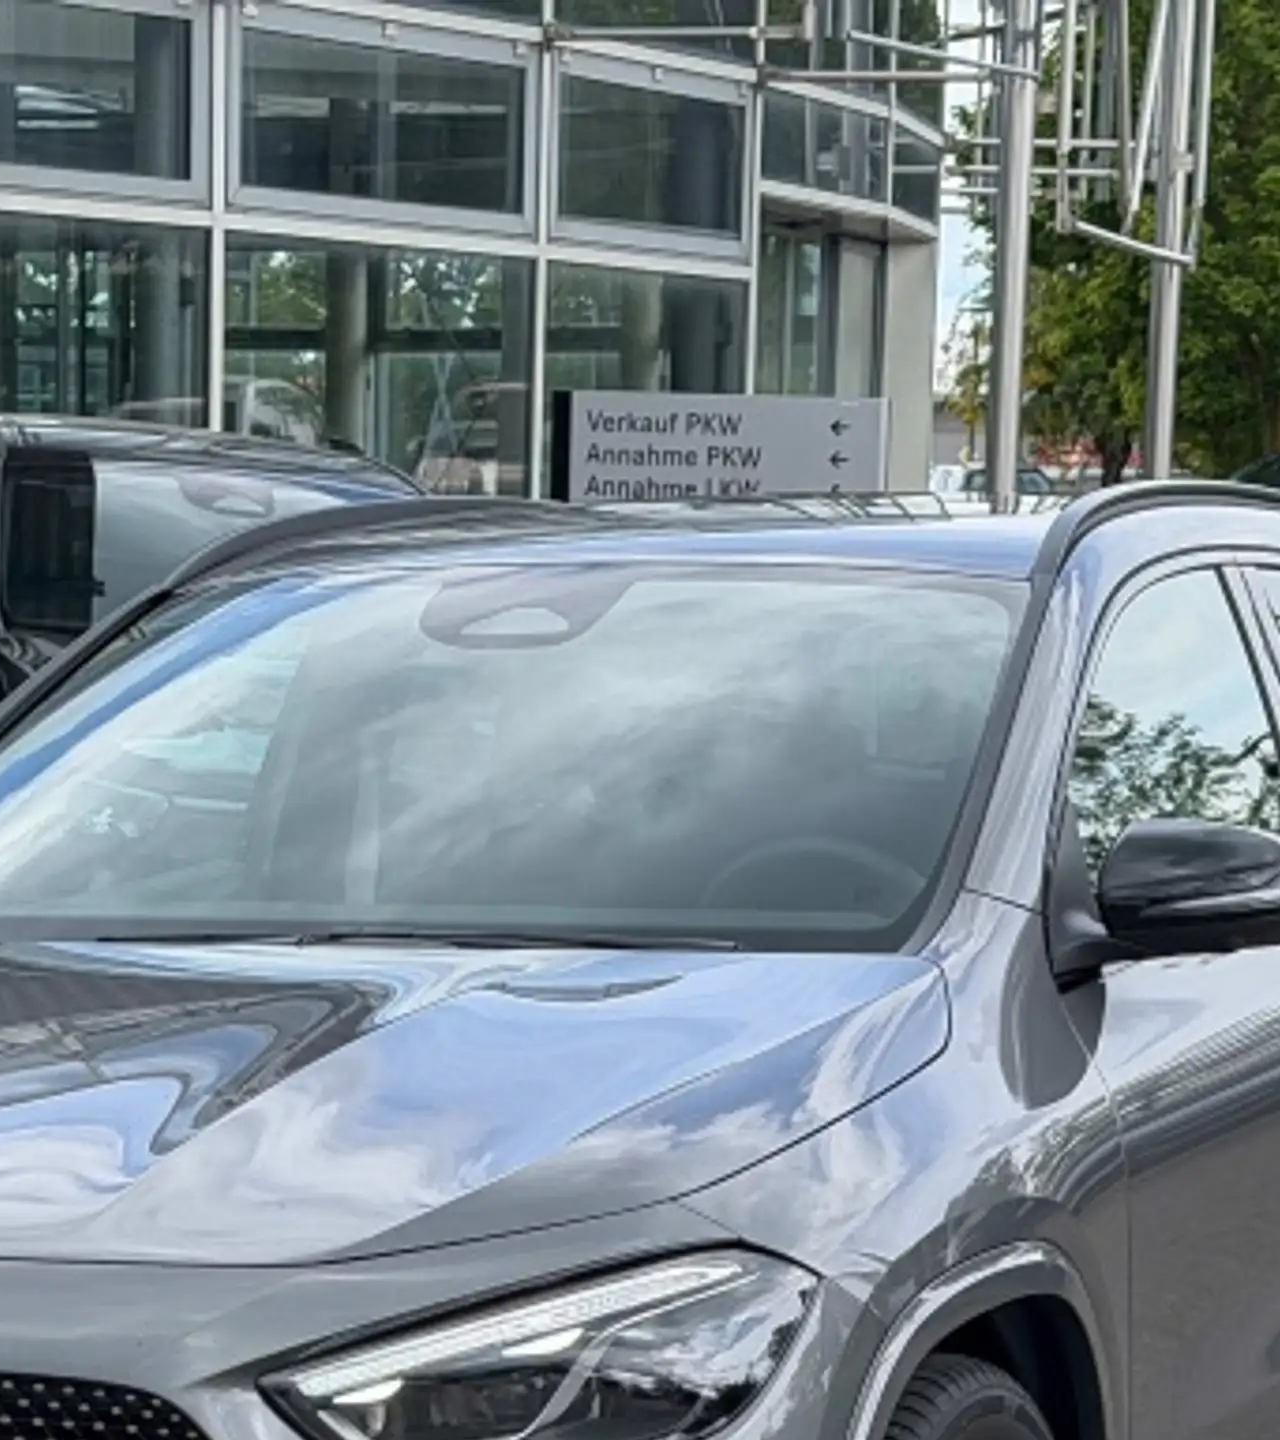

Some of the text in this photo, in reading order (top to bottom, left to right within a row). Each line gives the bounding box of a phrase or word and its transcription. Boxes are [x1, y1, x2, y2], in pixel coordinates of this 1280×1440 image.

[587, 409, 743, 436] Verkauf PKW
[585, 442, 762, 468] Annahme PKW
[584, 474, 698, 499] Annahme
